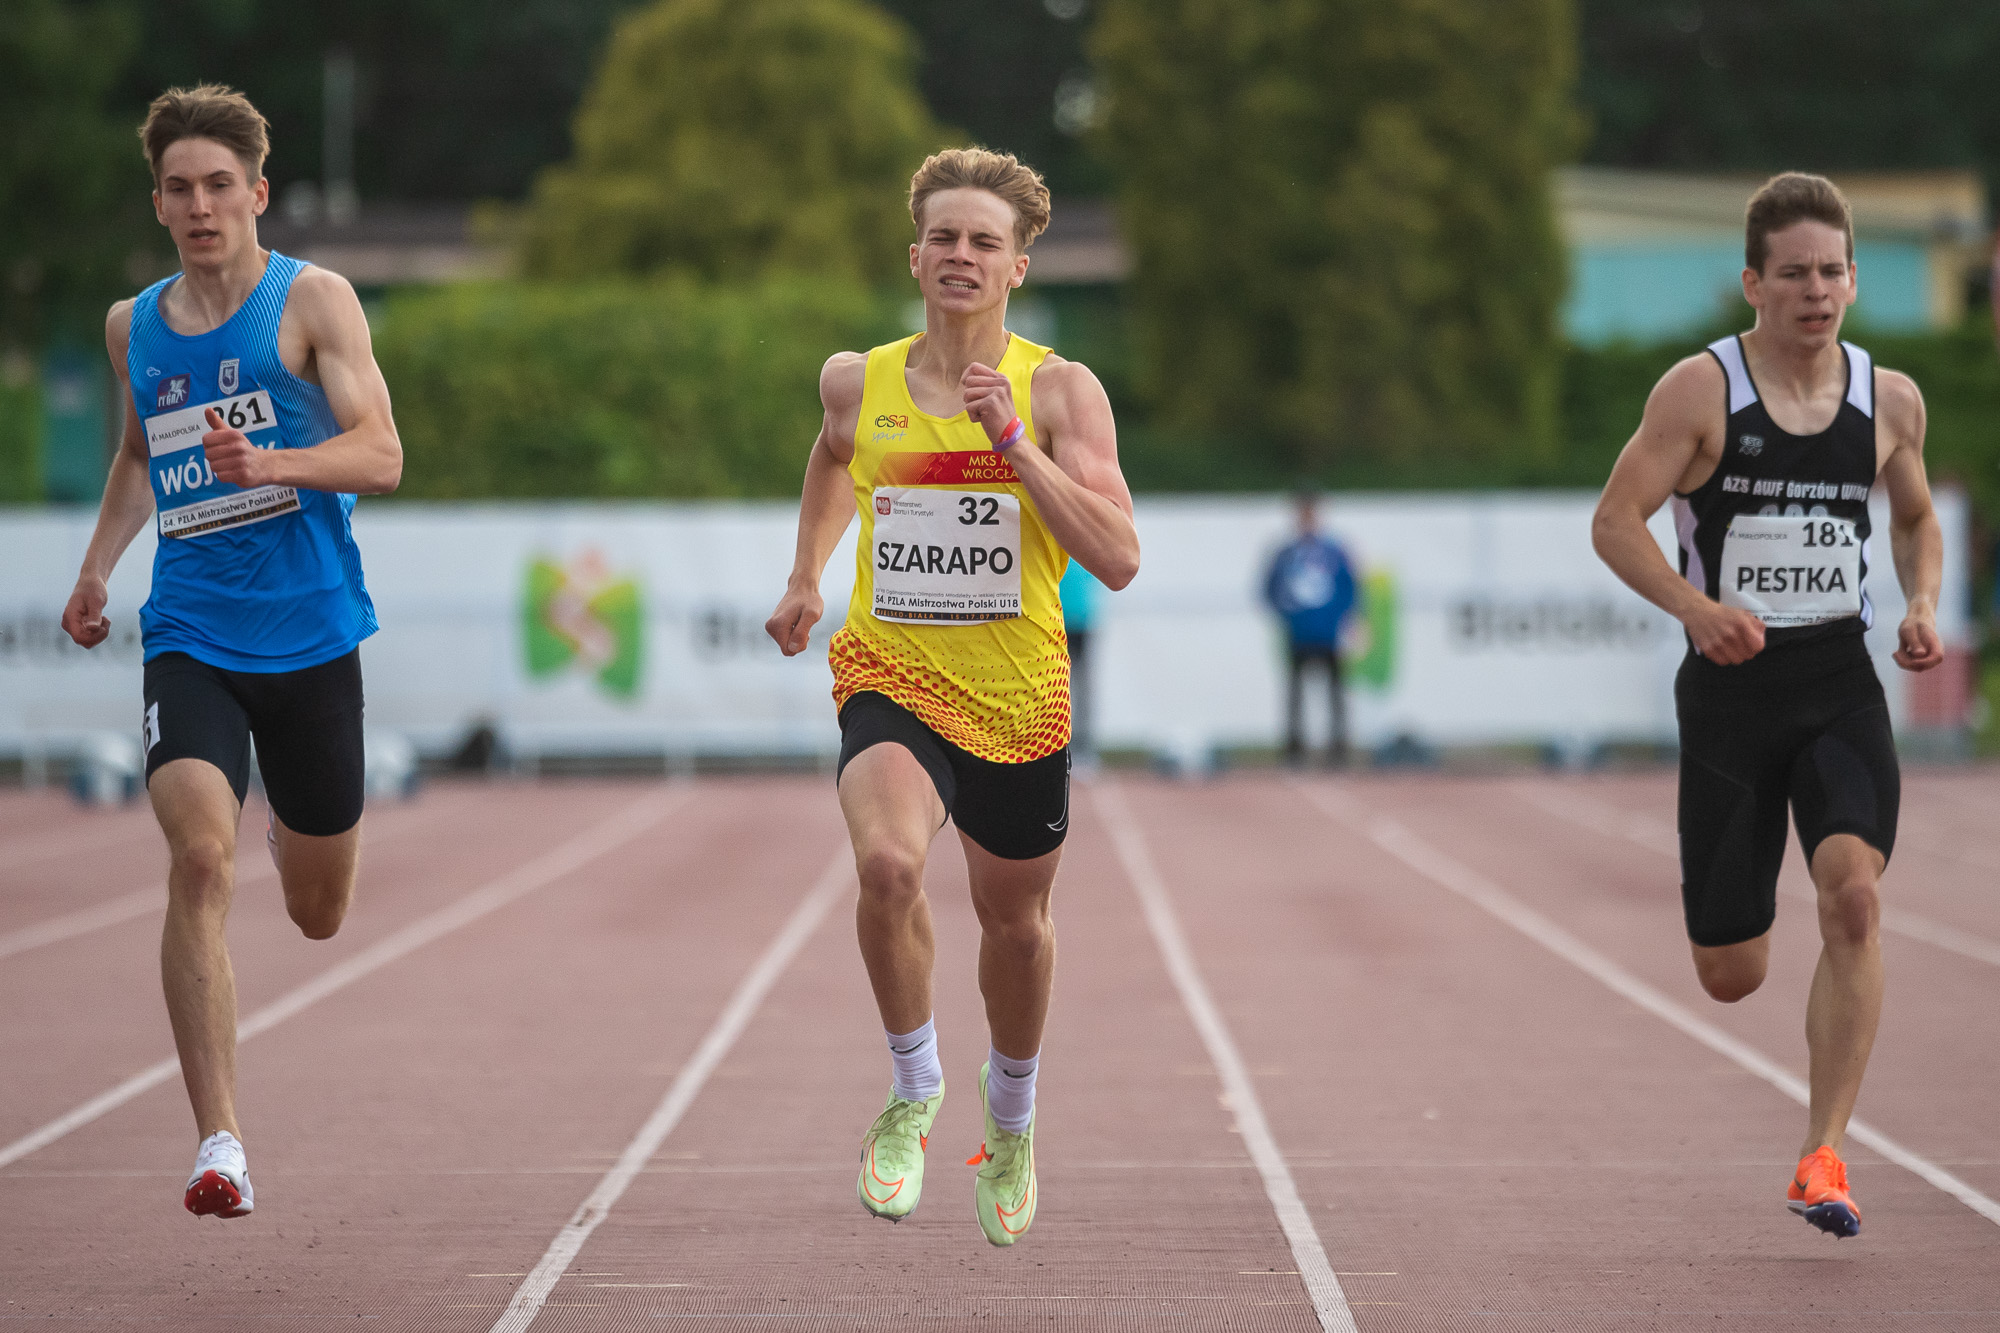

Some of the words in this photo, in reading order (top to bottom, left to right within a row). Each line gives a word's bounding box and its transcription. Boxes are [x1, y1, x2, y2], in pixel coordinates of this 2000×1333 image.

[158, 424, 201, 441] MAŁOPOLSKA
[159, 441, 276, 496] WÓJ
[961, 468, 1019, 479] WROCŁA
[968, 455, 997, 467] MKS
[1722, 477, 1749, 493] AZS
[1753, 480, 1784, 497] AWF
[1786, 481, 1838, 500] Gorzów
[163, 518, 176, 528] 54.
[177, 513, 197, 525] PZLA
[197, 500, 247, 520] Mistrzostwa
[248, 493, 276, 507] Polski
[277, 488, 295, 500] U18
[958, 497, 1000, 526] 32
[1802, 521, 1853, 547] 181
[877, 541, 1013, 575] SZARAPO
[1737, 566, 1847, 593] PESTKA
[875, 595, 886, 605] 54.
[887, 596, 906, 607] PZLA
[908, 598, 965, 609] Mistrzostwa
[968, 599, 997, 609] Polski
[1000, 599, 1019, 608] U18
